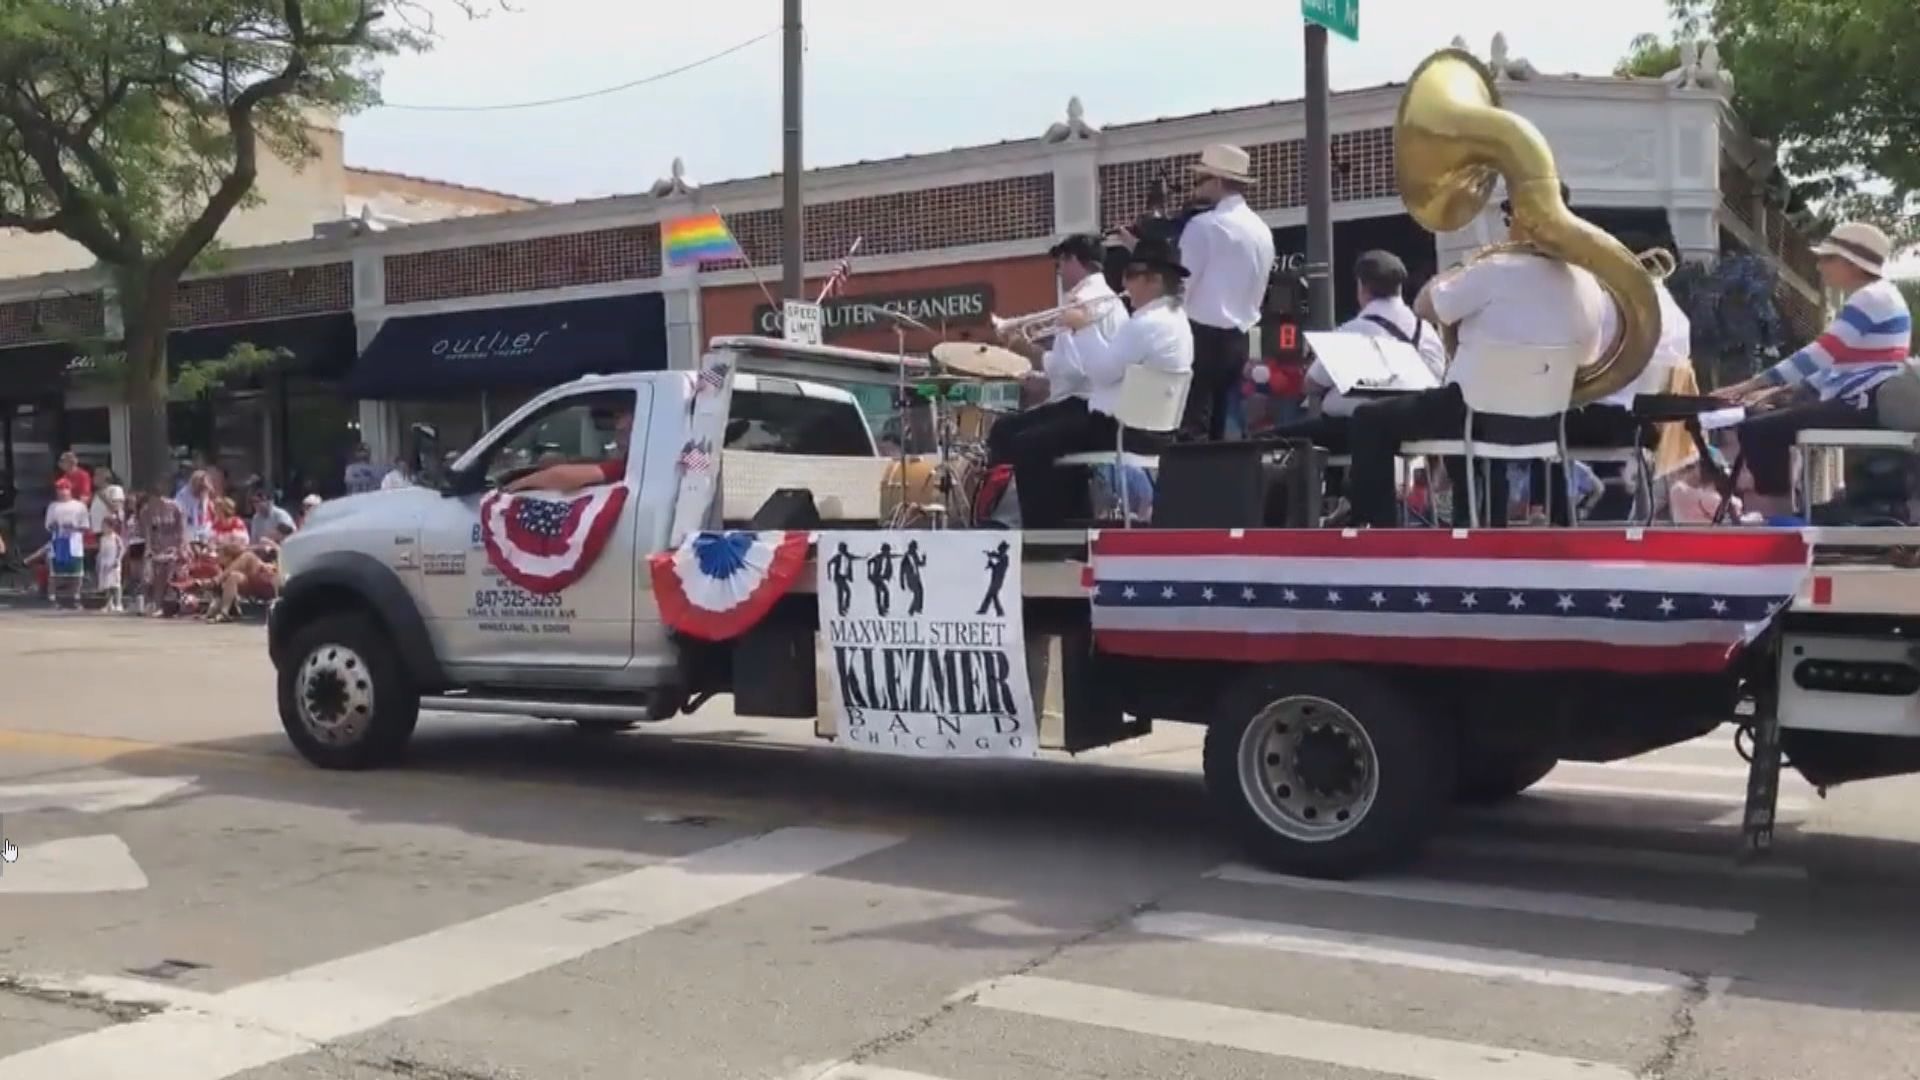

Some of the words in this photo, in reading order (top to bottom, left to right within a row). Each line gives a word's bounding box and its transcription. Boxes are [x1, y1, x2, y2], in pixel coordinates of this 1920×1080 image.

[1271, 252, 1304, 272] SIC
[830, 619, 925, 645] MAXWELL
[929, 621, 1006, 647] STREET
[833, 646, 1017, 715] KLEZMER
[846, 706, 1020, 735] BAND
[850, 729, 1022, 750] CHICAGO
